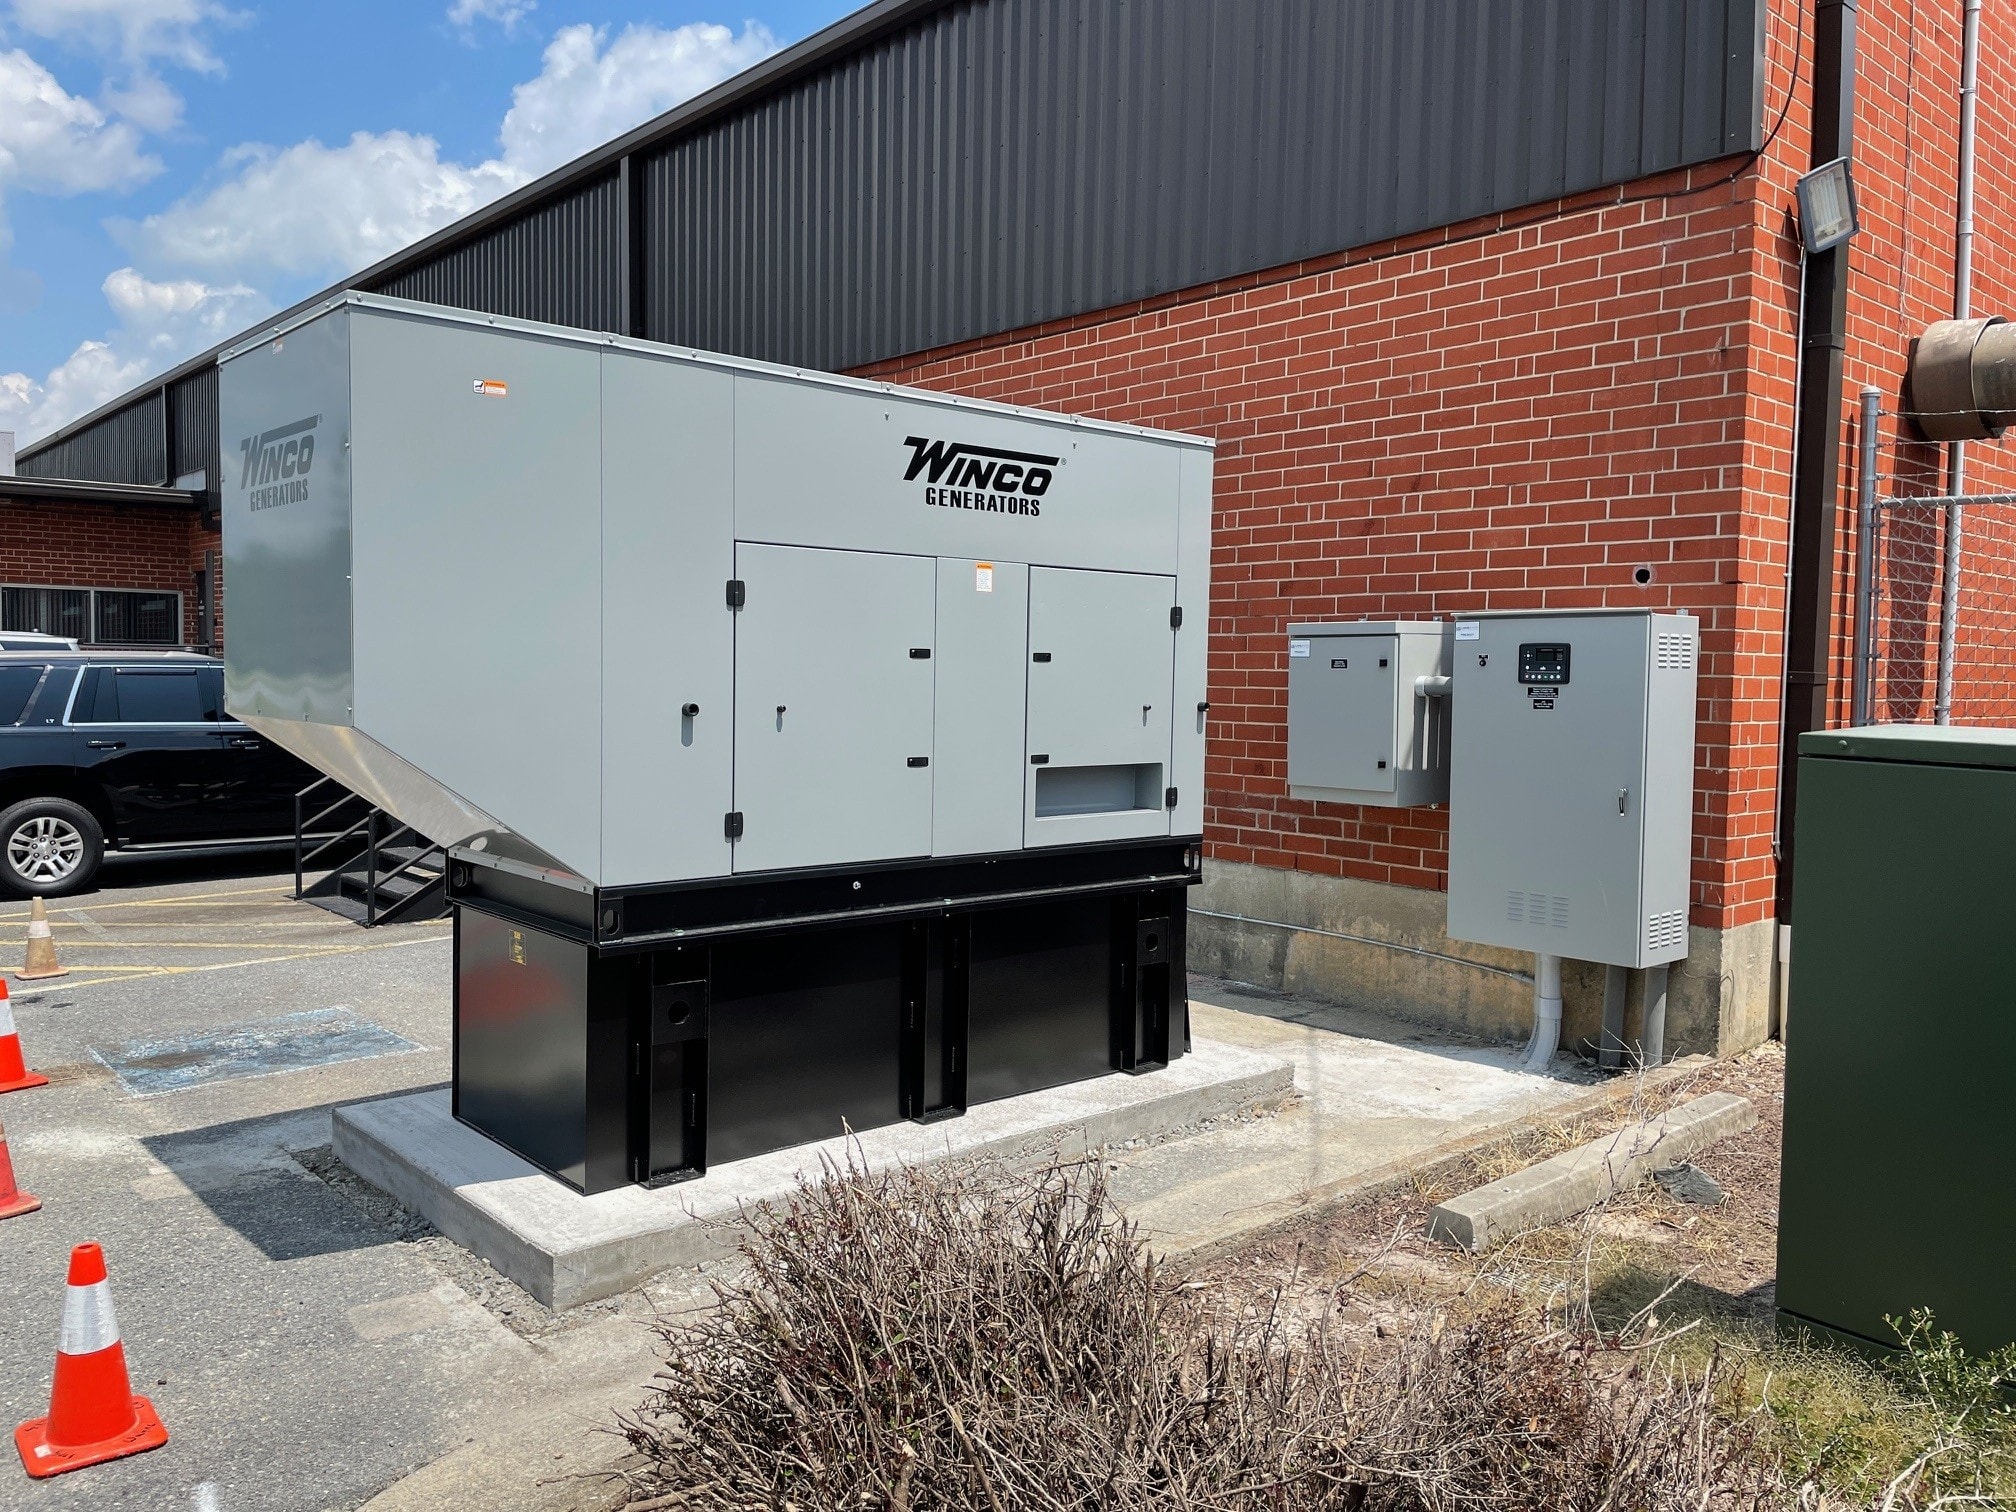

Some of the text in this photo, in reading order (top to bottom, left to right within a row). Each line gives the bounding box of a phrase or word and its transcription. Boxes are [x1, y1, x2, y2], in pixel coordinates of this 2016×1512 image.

[240, 414, 319, 490] WINCO
[903, 435, 1060, 496] WINCO
[250, 478, 309, 512] GENERATORS
[925, 487, 1040, 517] GENERATORS
